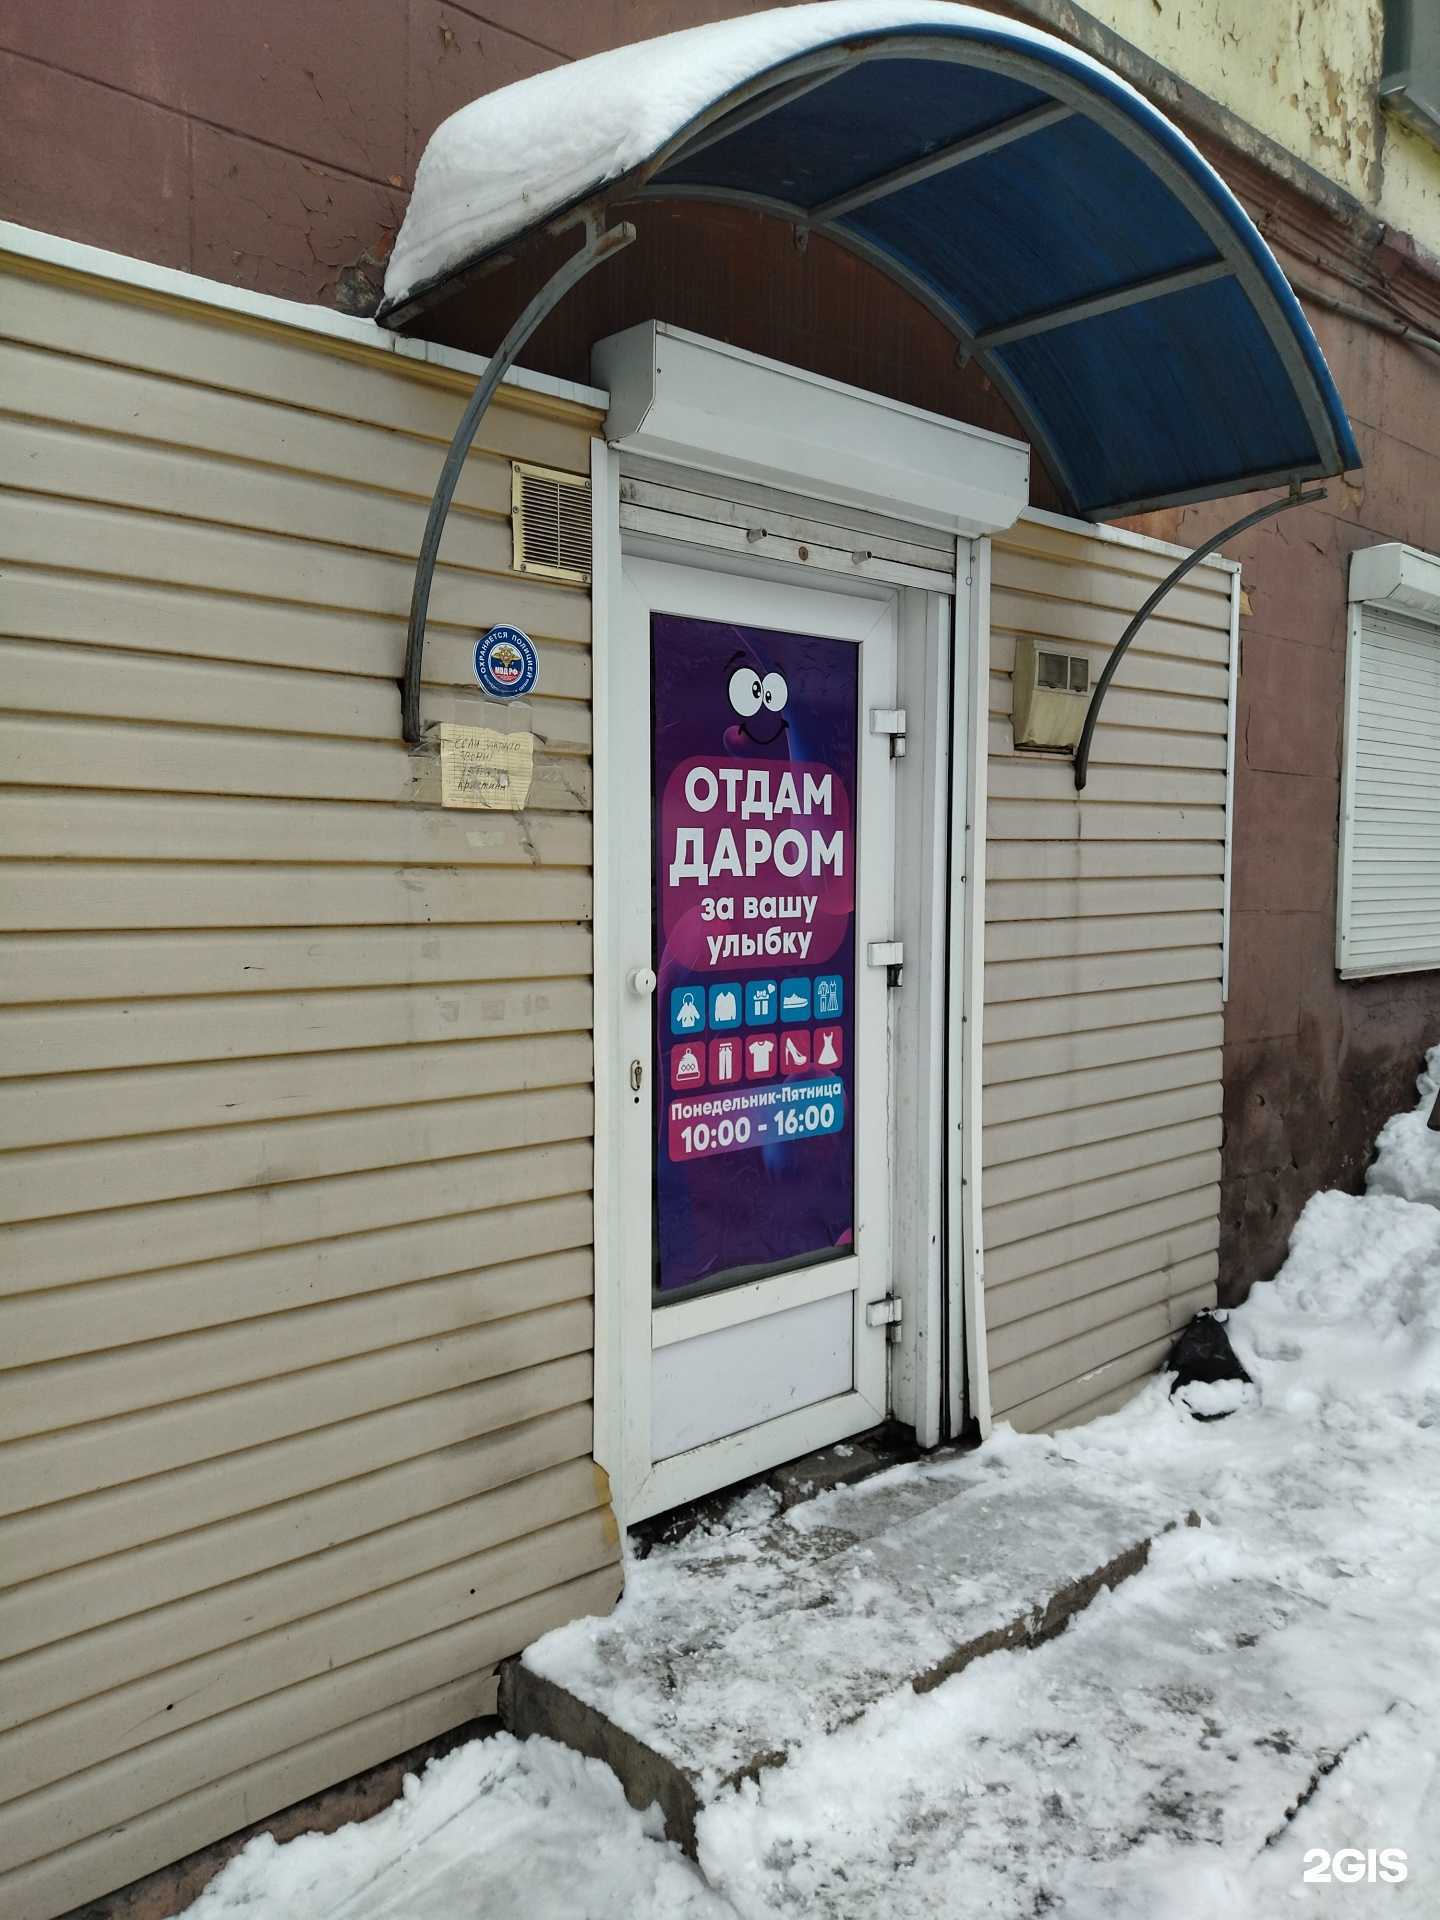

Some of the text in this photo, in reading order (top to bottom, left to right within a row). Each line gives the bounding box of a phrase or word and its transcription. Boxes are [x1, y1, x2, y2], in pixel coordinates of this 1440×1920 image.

[479, 631, 534, 679] ОХРАНЯЕТСЯ ПОЛИЦИЕЙ
[685, 766, 832, 821] ОТДАМ
[669, 828, 844, 887] ДАРОМ
[700, 896, 818, 924] за вашу
[706, 926, 813, 965] улыбку
[671, 1082, 841, 1121] Понедельник-Пятница
[680, 1116, 751, 1153] 10:00
[773, 1103, 835, 1136] 16:00
